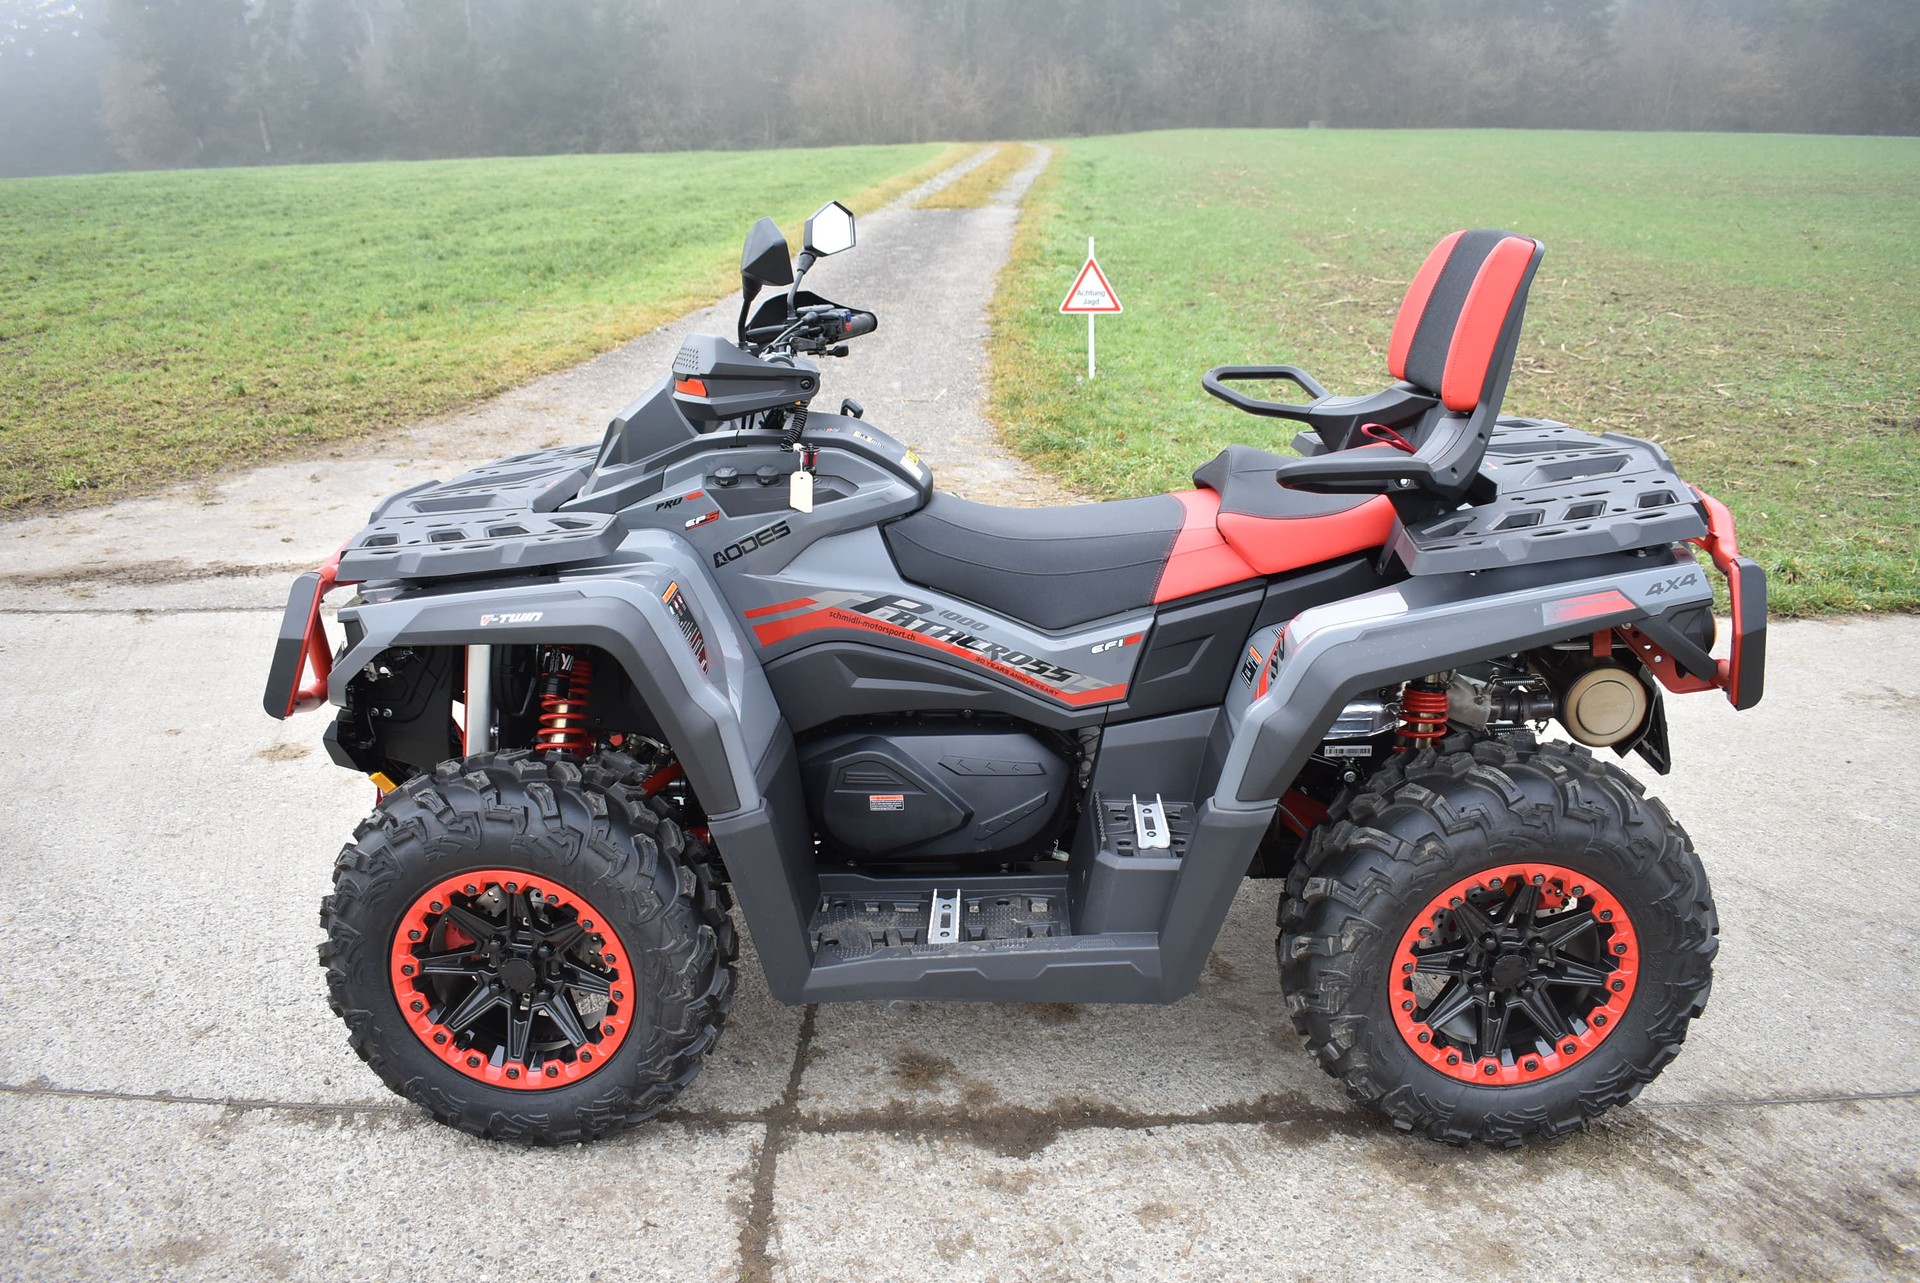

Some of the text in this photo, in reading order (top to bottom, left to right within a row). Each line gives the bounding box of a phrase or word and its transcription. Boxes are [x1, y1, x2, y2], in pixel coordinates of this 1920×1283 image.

[655, 496, 683, 512] PRO
[712, 520, 791, 568] AODES
[1645, 573, 1698, 597] 4X4
[828, 611, 916, 641] schmidli-motorsport.ch
[938, 609, 990, 632] 1000
[1090, 638, 1125, 655] EFI
[975, 656, 1060, 697] 30 YEARS ANNIVERSARY
